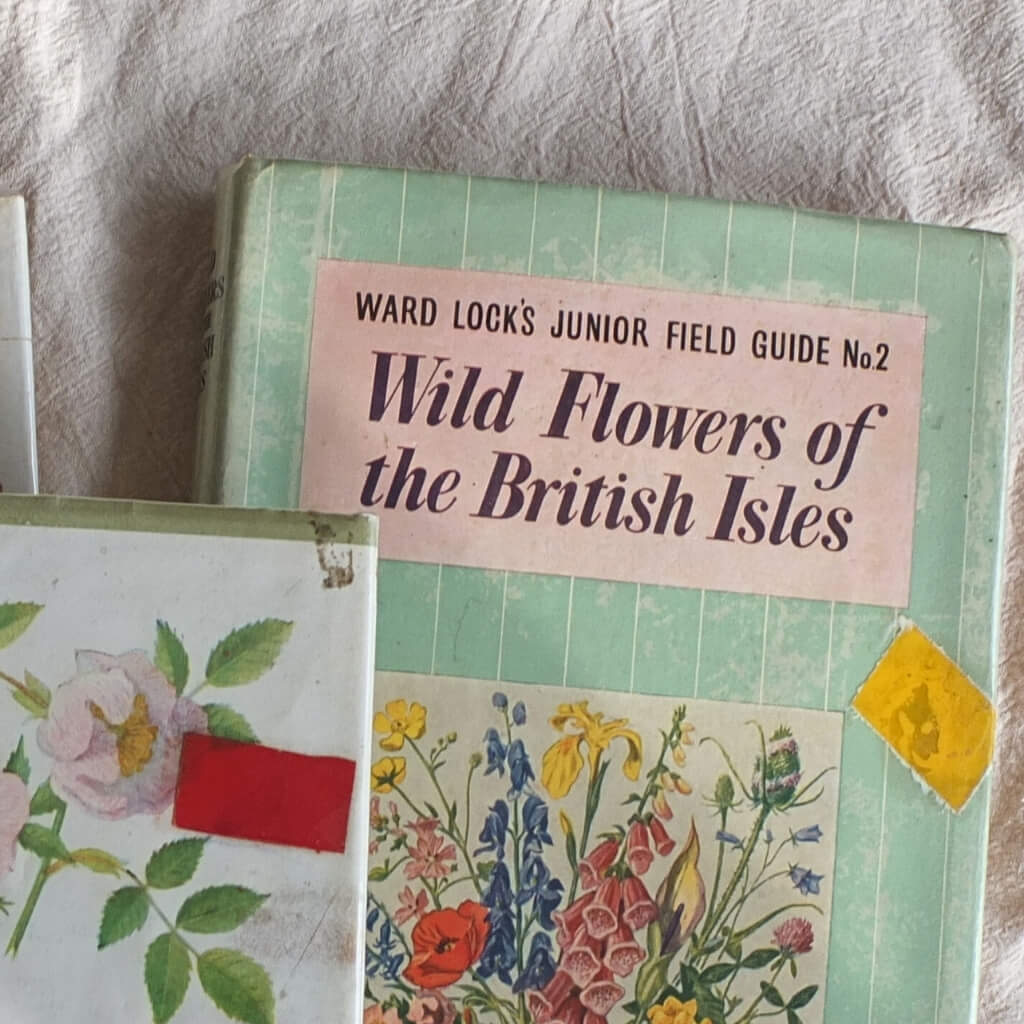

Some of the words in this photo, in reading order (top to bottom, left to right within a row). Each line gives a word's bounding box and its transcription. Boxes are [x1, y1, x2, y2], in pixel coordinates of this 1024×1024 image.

[356, 292, 437, 326] WARD
[454, 298, 535, 336] LOCK'S
[551, 310, 648, 347] JUNIOR
[667, 321, 735, 355] FIELD
[752, 330, 830, 365] GUIDE
[369, 351, 524, 433] Wild
[539, 369, 786, 460] Flowers
[807, 404, 888, 491] of
[360, 446, 461, 513] the
[470, 451, 695, 536] British
[706, 472, 853, 552] Isles
